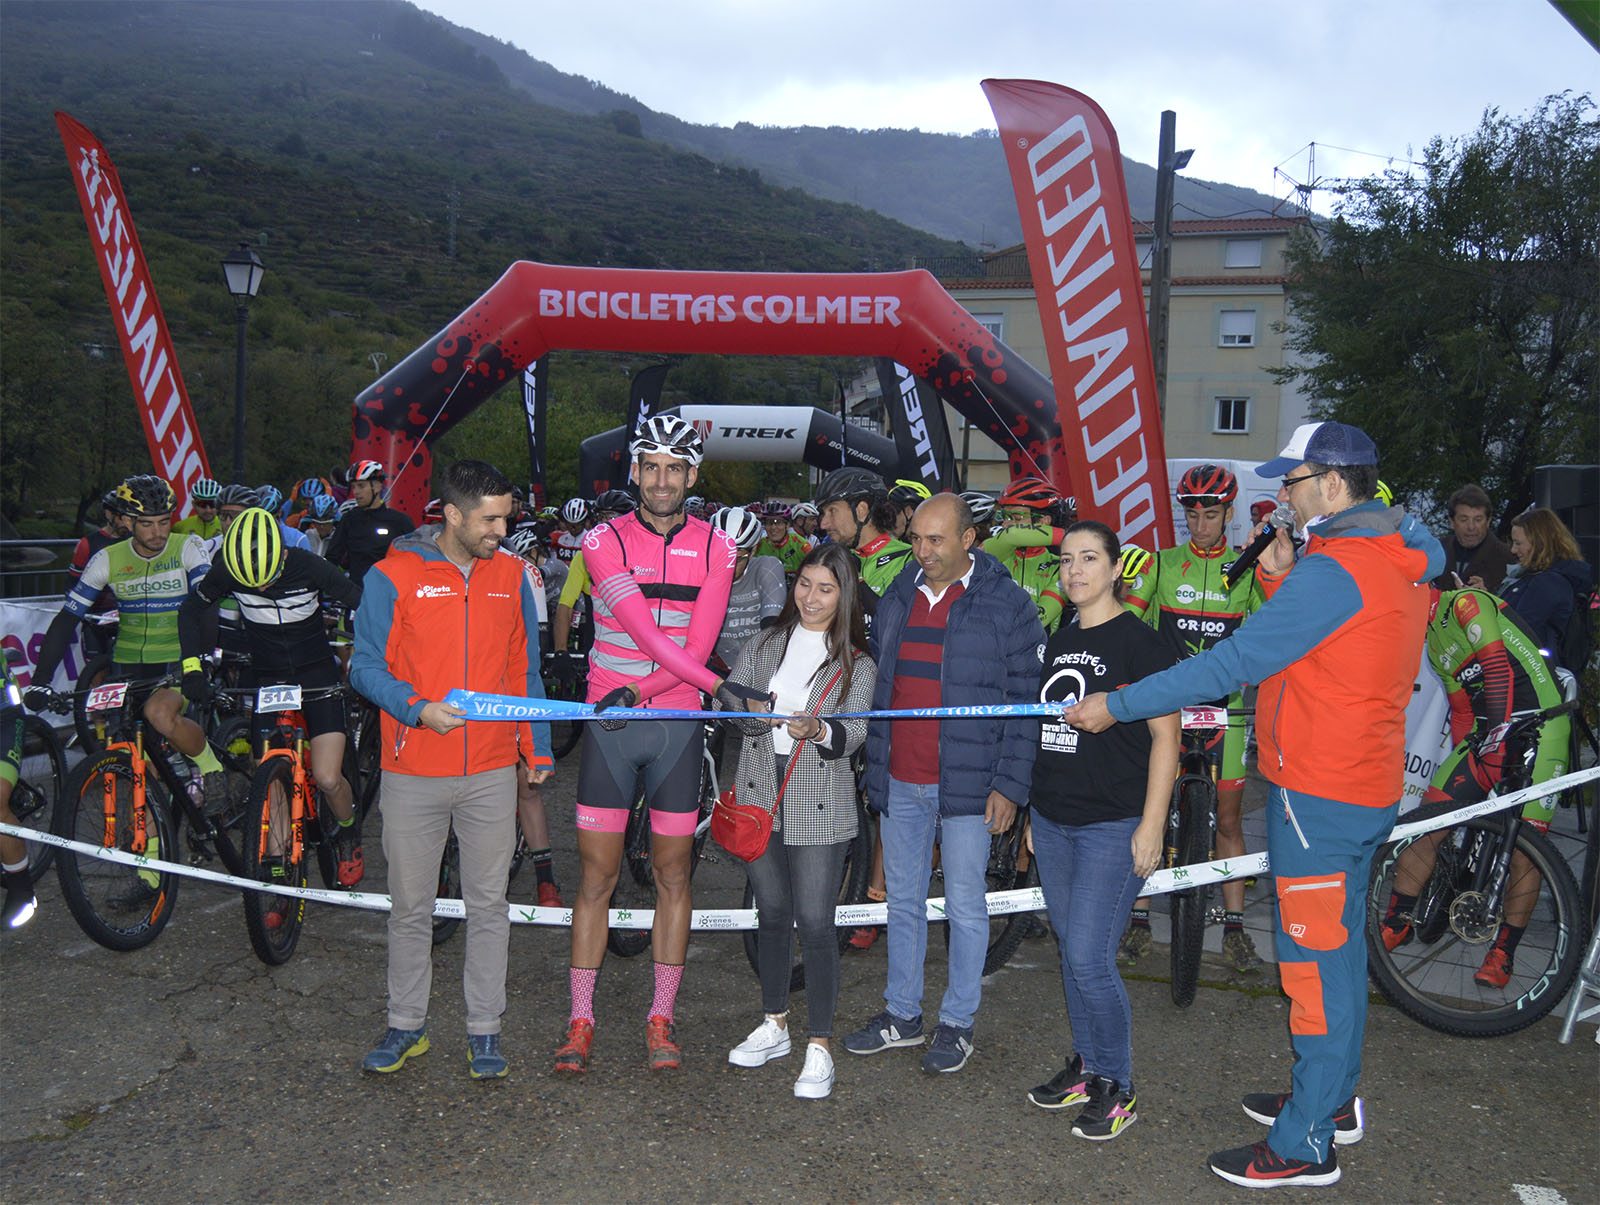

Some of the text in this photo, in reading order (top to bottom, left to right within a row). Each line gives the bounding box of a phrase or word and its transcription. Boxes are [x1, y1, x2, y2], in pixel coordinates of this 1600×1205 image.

[539, 288, 902, 328] BICICLETAS COLMER
[719, 426, 798, 439] TREK
[828, 440, 881, 466] BOTRAGER
[423, 584, 451, 593] Picota
[1176, 589, 1227, 601] ecopilas
[1501, 628, 1547, 684] Extremadura
[92, 691, 120, 704] 15A
[263, 690, 294, 704] 51A
[474, 701, 553, 718] VICTORY
[1193, 712, 1216, 722] 2B
[1453, 799, 1498, 820] Extremadura
